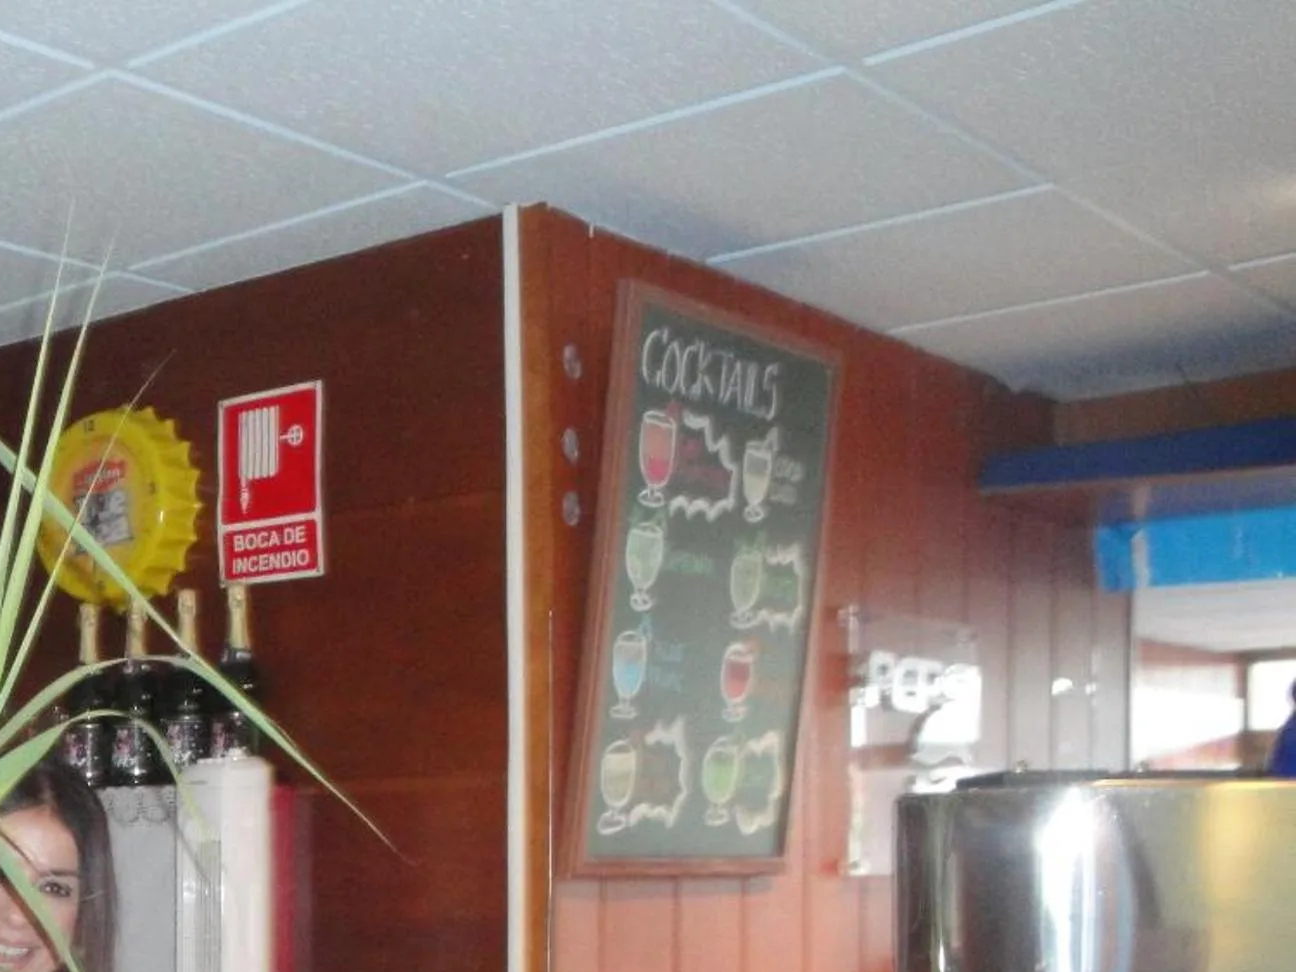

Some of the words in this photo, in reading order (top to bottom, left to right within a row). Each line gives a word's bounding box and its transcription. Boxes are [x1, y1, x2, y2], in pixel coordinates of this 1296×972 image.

[642, 325, 780, 421] COCKTAILS
[232, 533, 281, 552] BOCA
[283, 525, 308, 545] DE
[232, 548, 310, 575] INCENDIO
